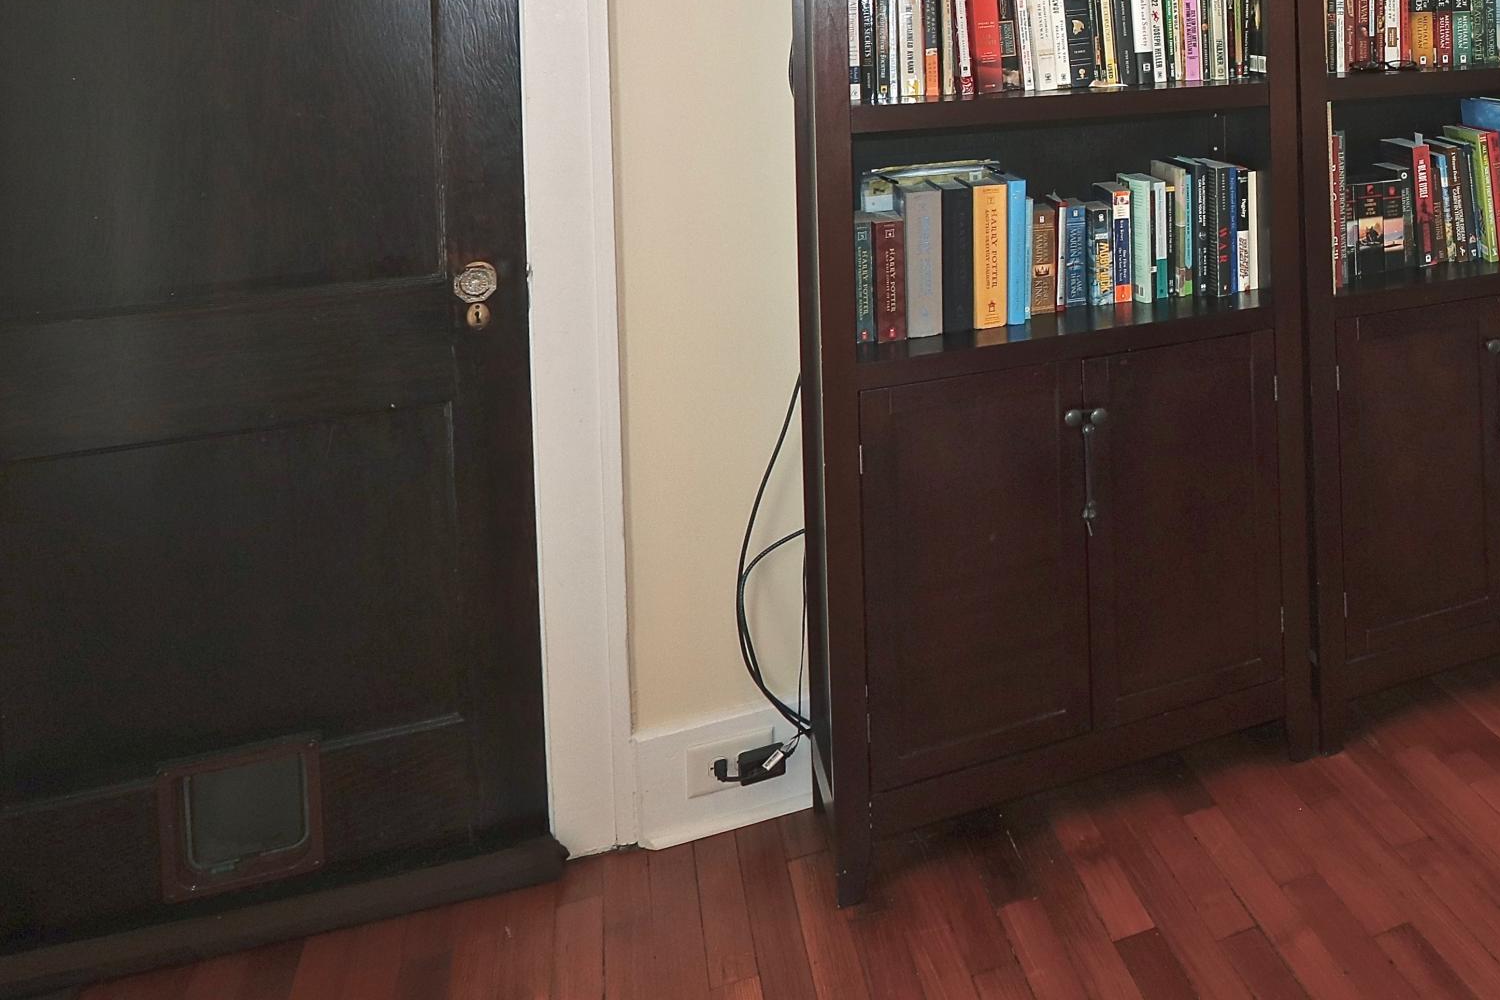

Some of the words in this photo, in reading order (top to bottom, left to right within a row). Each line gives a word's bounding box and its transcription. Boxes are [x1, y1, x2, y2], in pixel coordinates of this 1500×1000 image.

[1153, 25, 1161, 46] JOSEPH
[1154, 48, 1162, 68] HELLER
[1418, 165, 1427, 183] BLADE
[1419, 183, 1428, 198] ITSELF
[1100, 243, 1110, 292] MOBY-DICK
